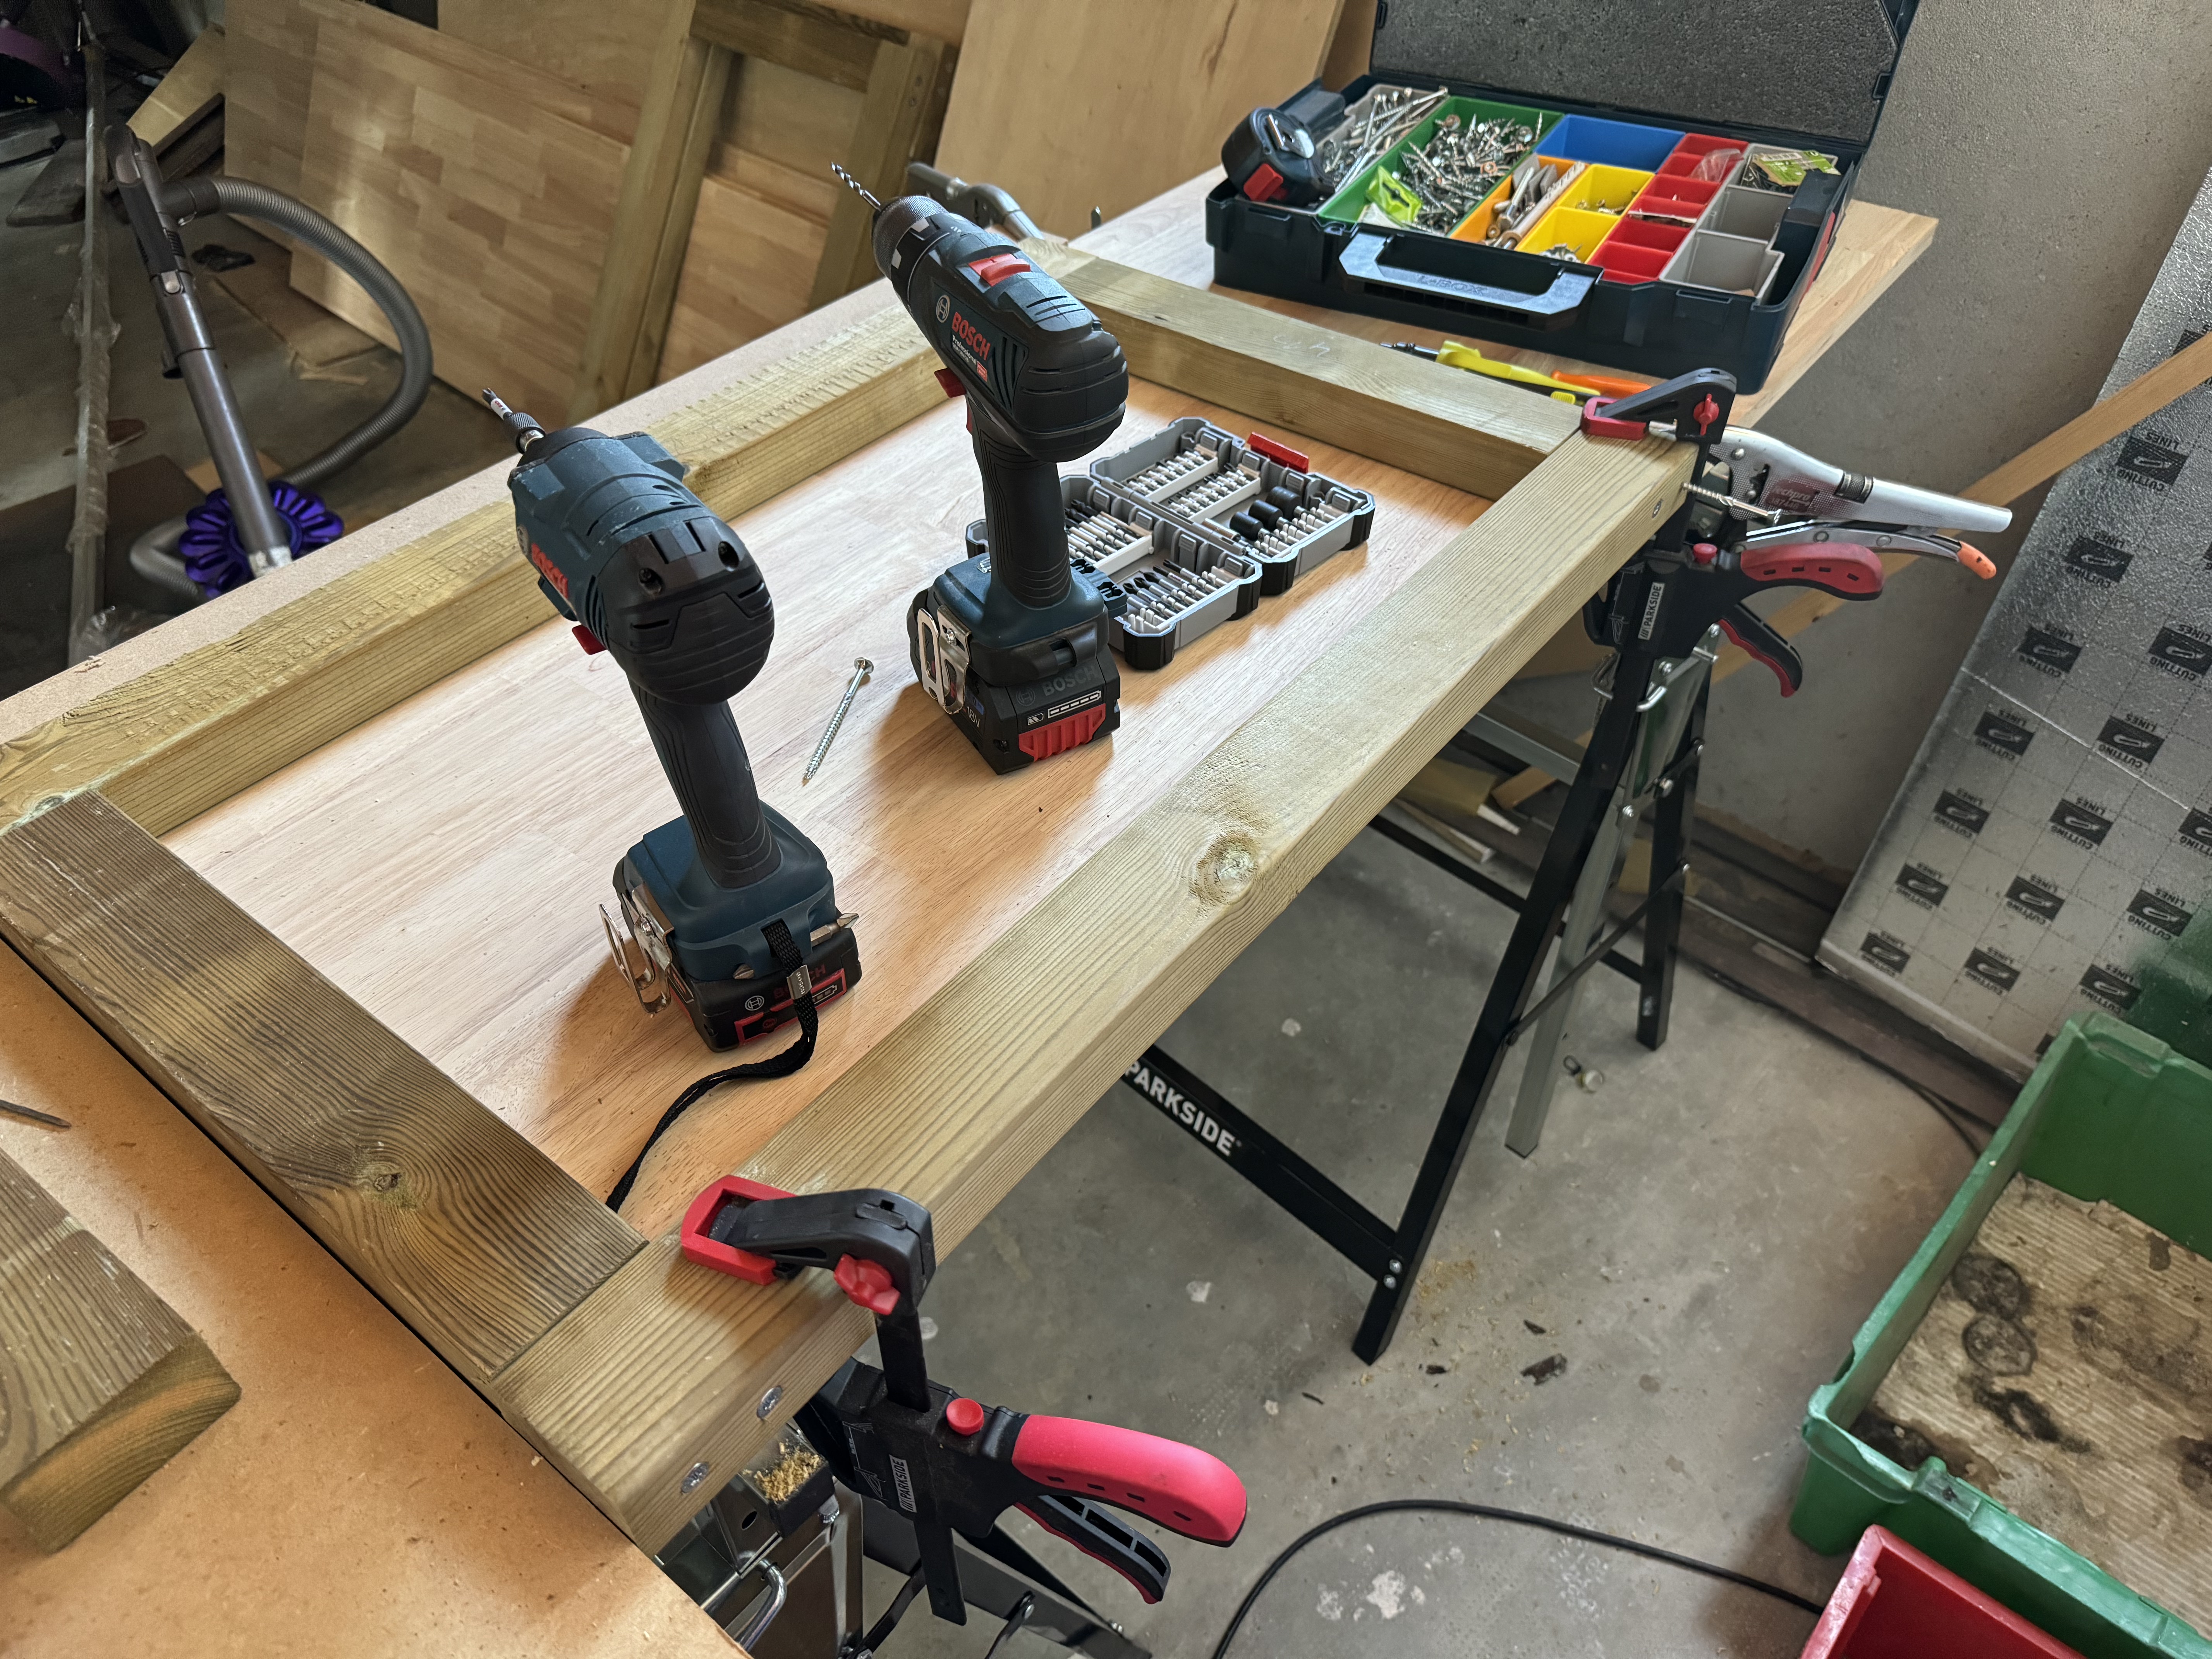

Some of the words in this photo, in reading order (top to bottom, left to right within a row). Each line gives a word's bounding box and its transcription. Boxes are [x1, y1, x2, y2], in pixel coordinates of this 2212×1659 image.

[951, 311, 991, 361] BOSCH
[952, 335, 977, 366] Professional
[2146, 431, 2179, 450] LINES
[2117, 468, 2165, 492] CUTTING
[531, 543, 568, 599] BOSCH
[1644, 585, 1662, 627] PARKSIDE
[2178, 624, 2211, 642] LINES
[2150, 656, 2196, 680] CUTTING
[1042, 665, 1096, 696] BOSCH
[966, 706, 980, 728] 18V
[1999, 709, 2027, 726] LINES
[2126, 713, 2157, 732] LINES
[1976, 737, 2015, 761] CUTTING
[2098, 744, 2143, 769] CUTTING
[2076, 796, 2106, 816] LINES
[2051, 825, 2092, 850] CUTTING
[2030, 874, 2058, 893] LINES
[2155, 888, 2186, 908] LINES
[2006, 899, 2046, 925] CUTTING
[2128, 914, 2171, 941] CUTTING
[795, 971, 805, 995] BOSCH
[2106, 964, 2134, 983] LINES
[2080, 988, 2122, 1015] CUTTING
[1125, 1060, 1236, 1157] PARKSIDE
[892, 1458, 912, 1500] PARKSIDE
